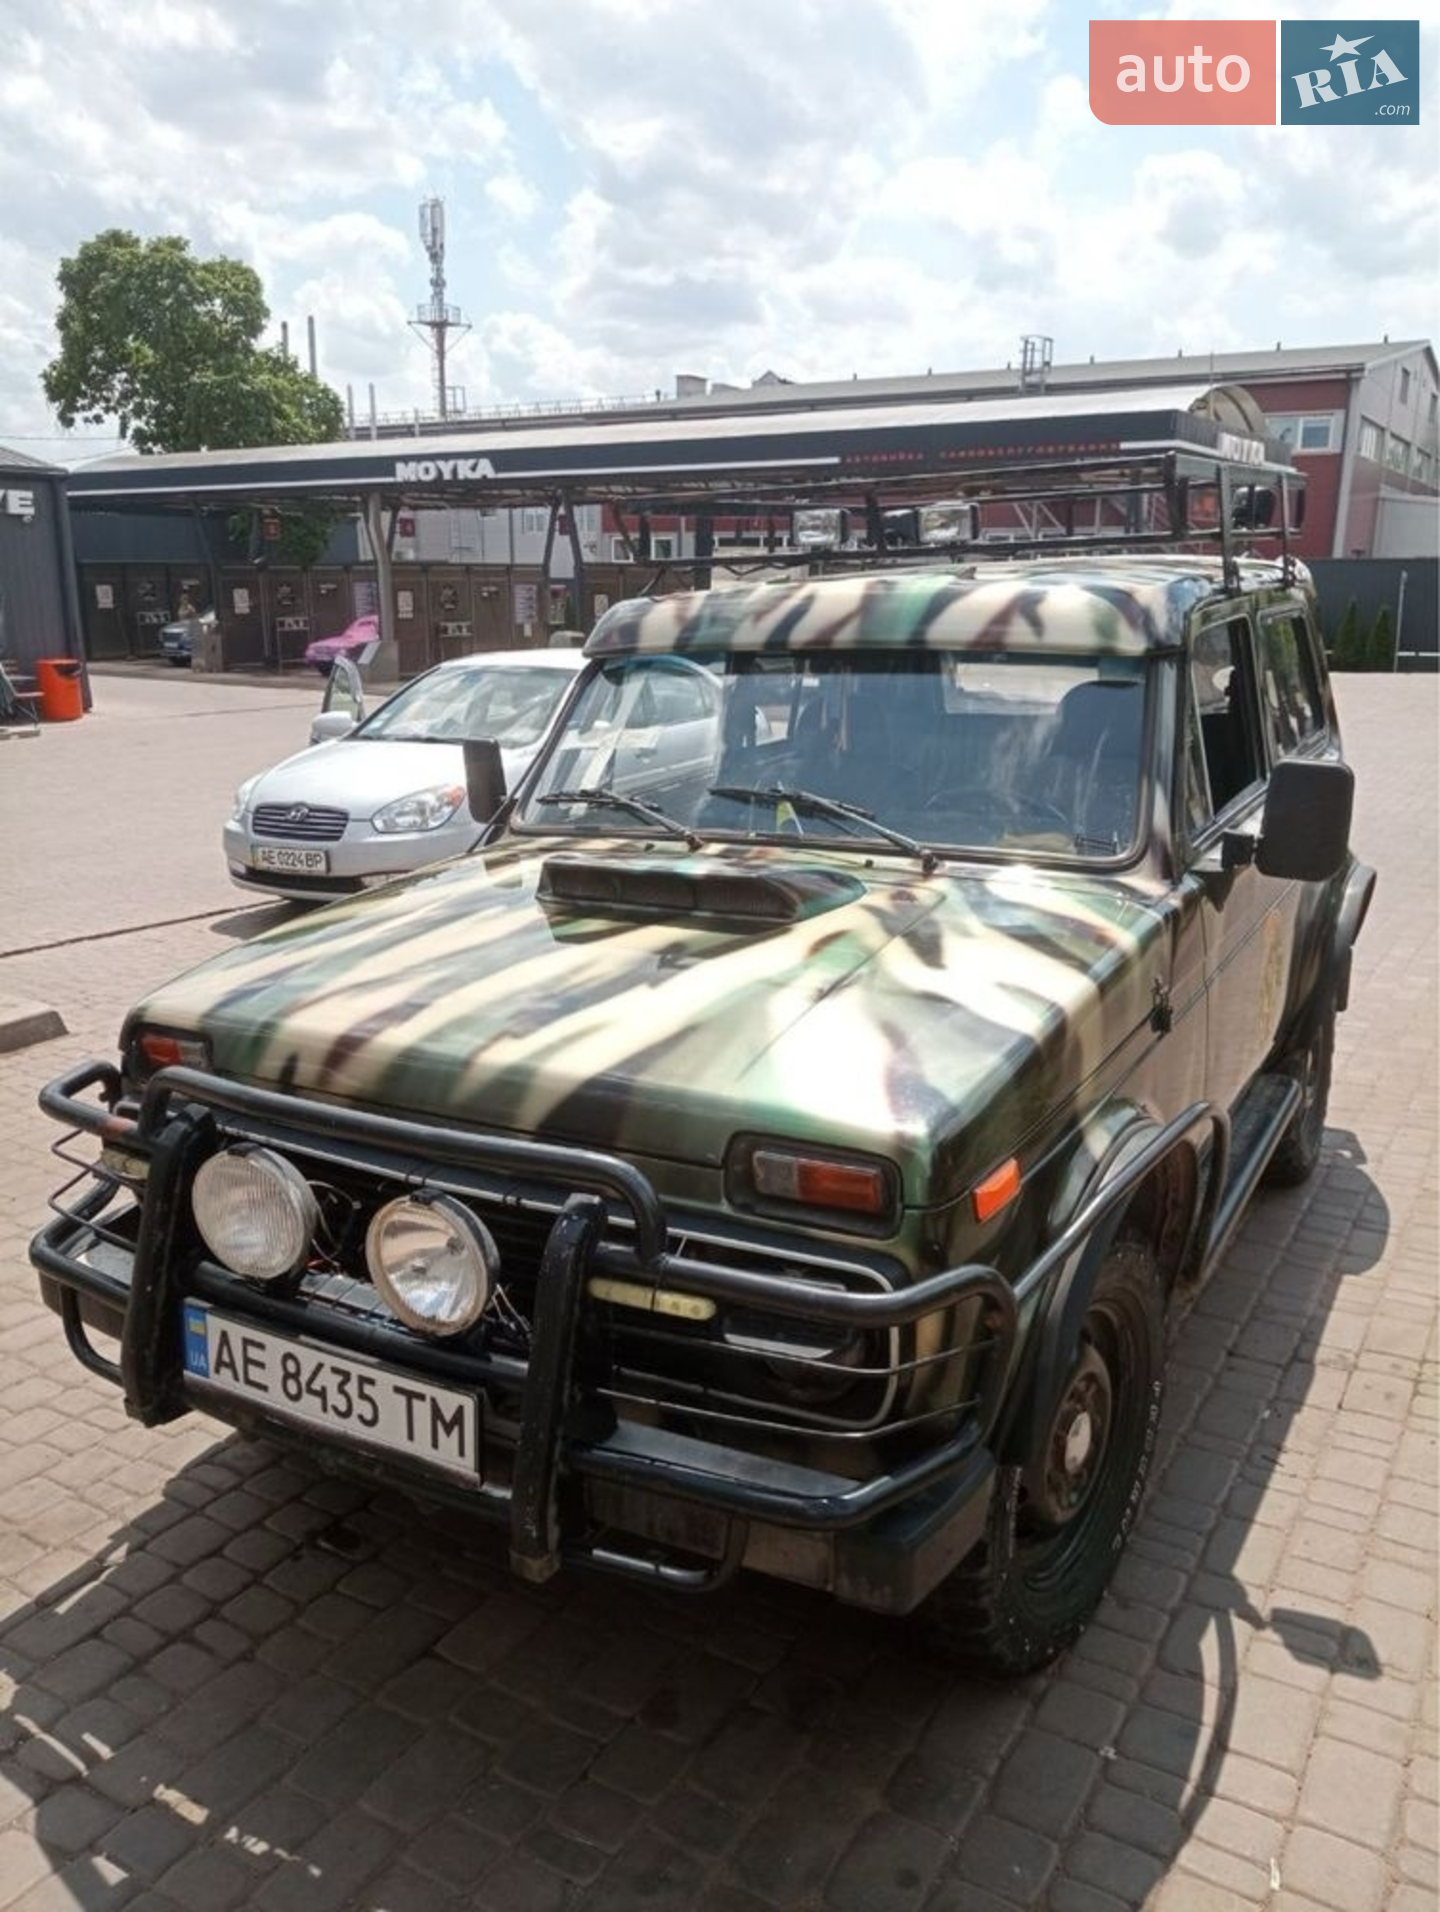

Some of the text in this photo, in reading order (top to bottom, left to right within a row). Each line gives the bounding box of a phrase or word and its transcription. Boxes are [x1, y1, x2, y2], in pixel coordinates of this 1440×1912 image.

[395, 458, 496, 482] MOYKA
[0, 488, 35, 516] E
[214, 1329, 466, 1458] AE 8435 TM
